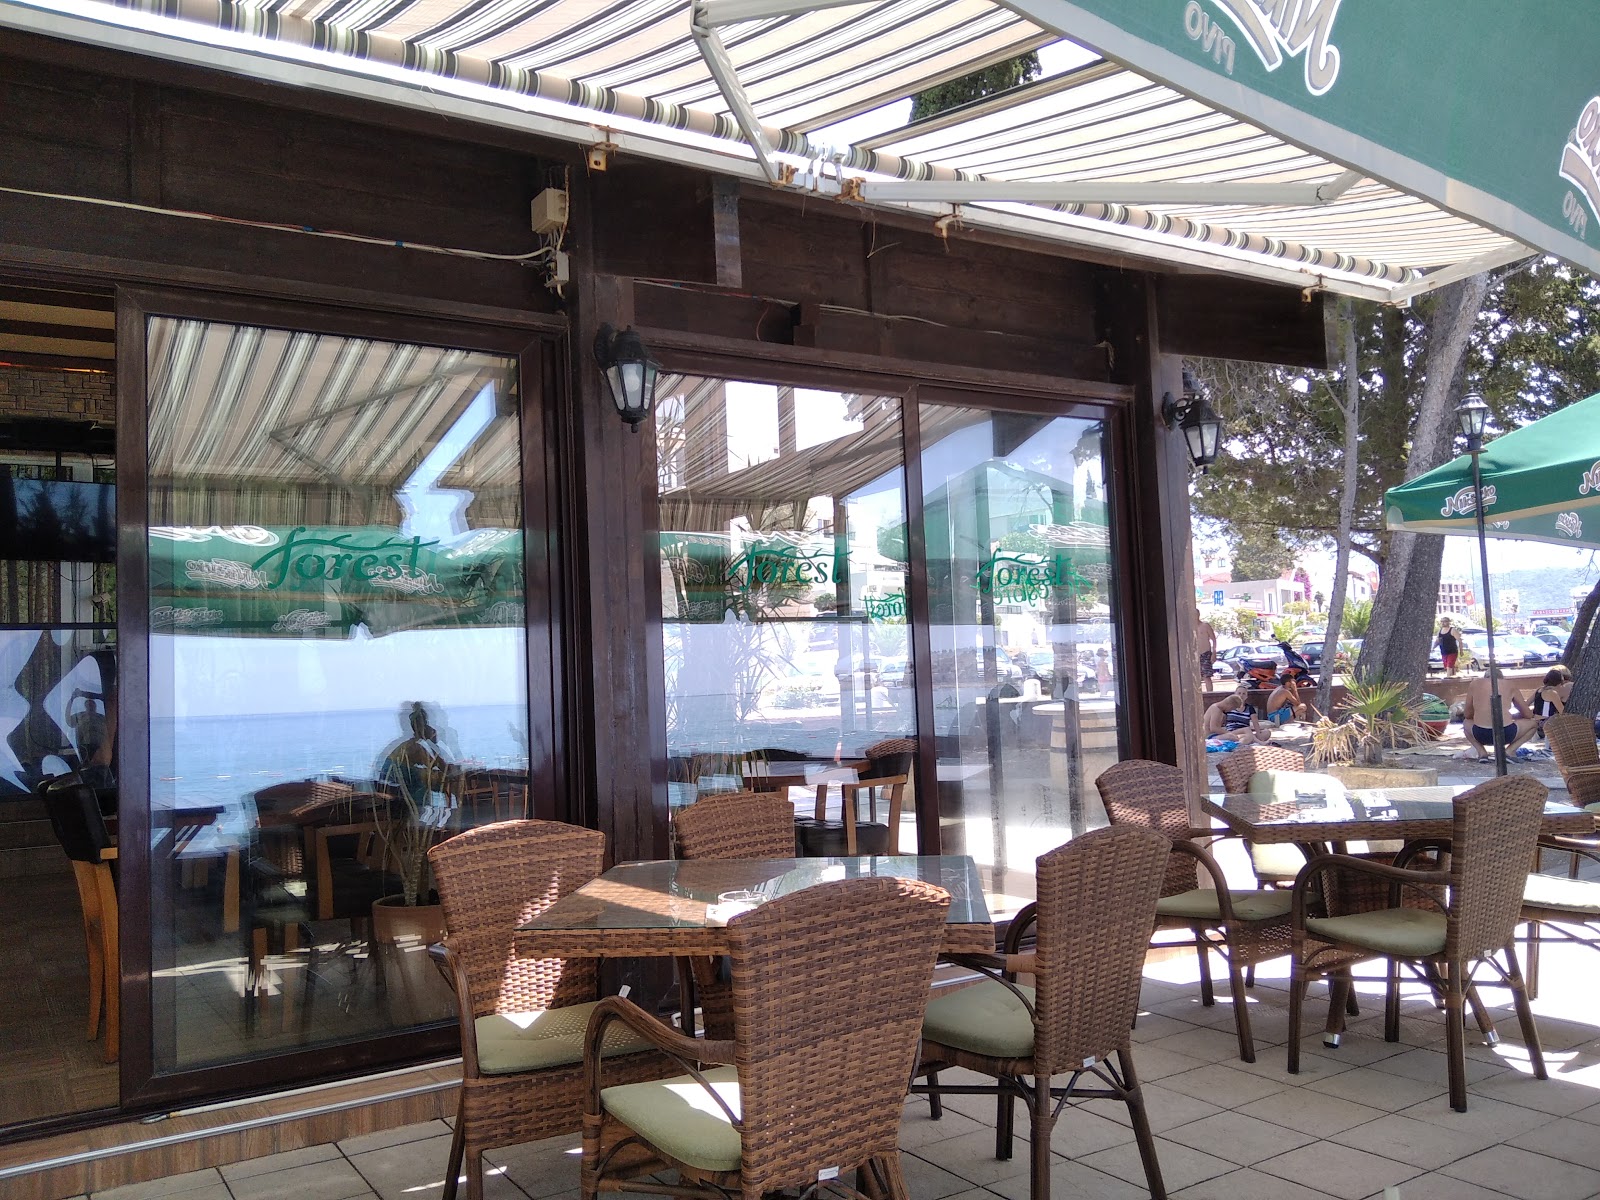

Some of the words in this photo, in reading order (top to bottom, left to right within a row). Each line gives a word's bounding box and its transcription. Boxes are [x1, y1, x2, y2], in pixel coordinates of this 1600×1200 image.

[251, 526, 440, 590] forest
[727, 539, 853, 591] forest
[975, 548, 1072, 593] forest
